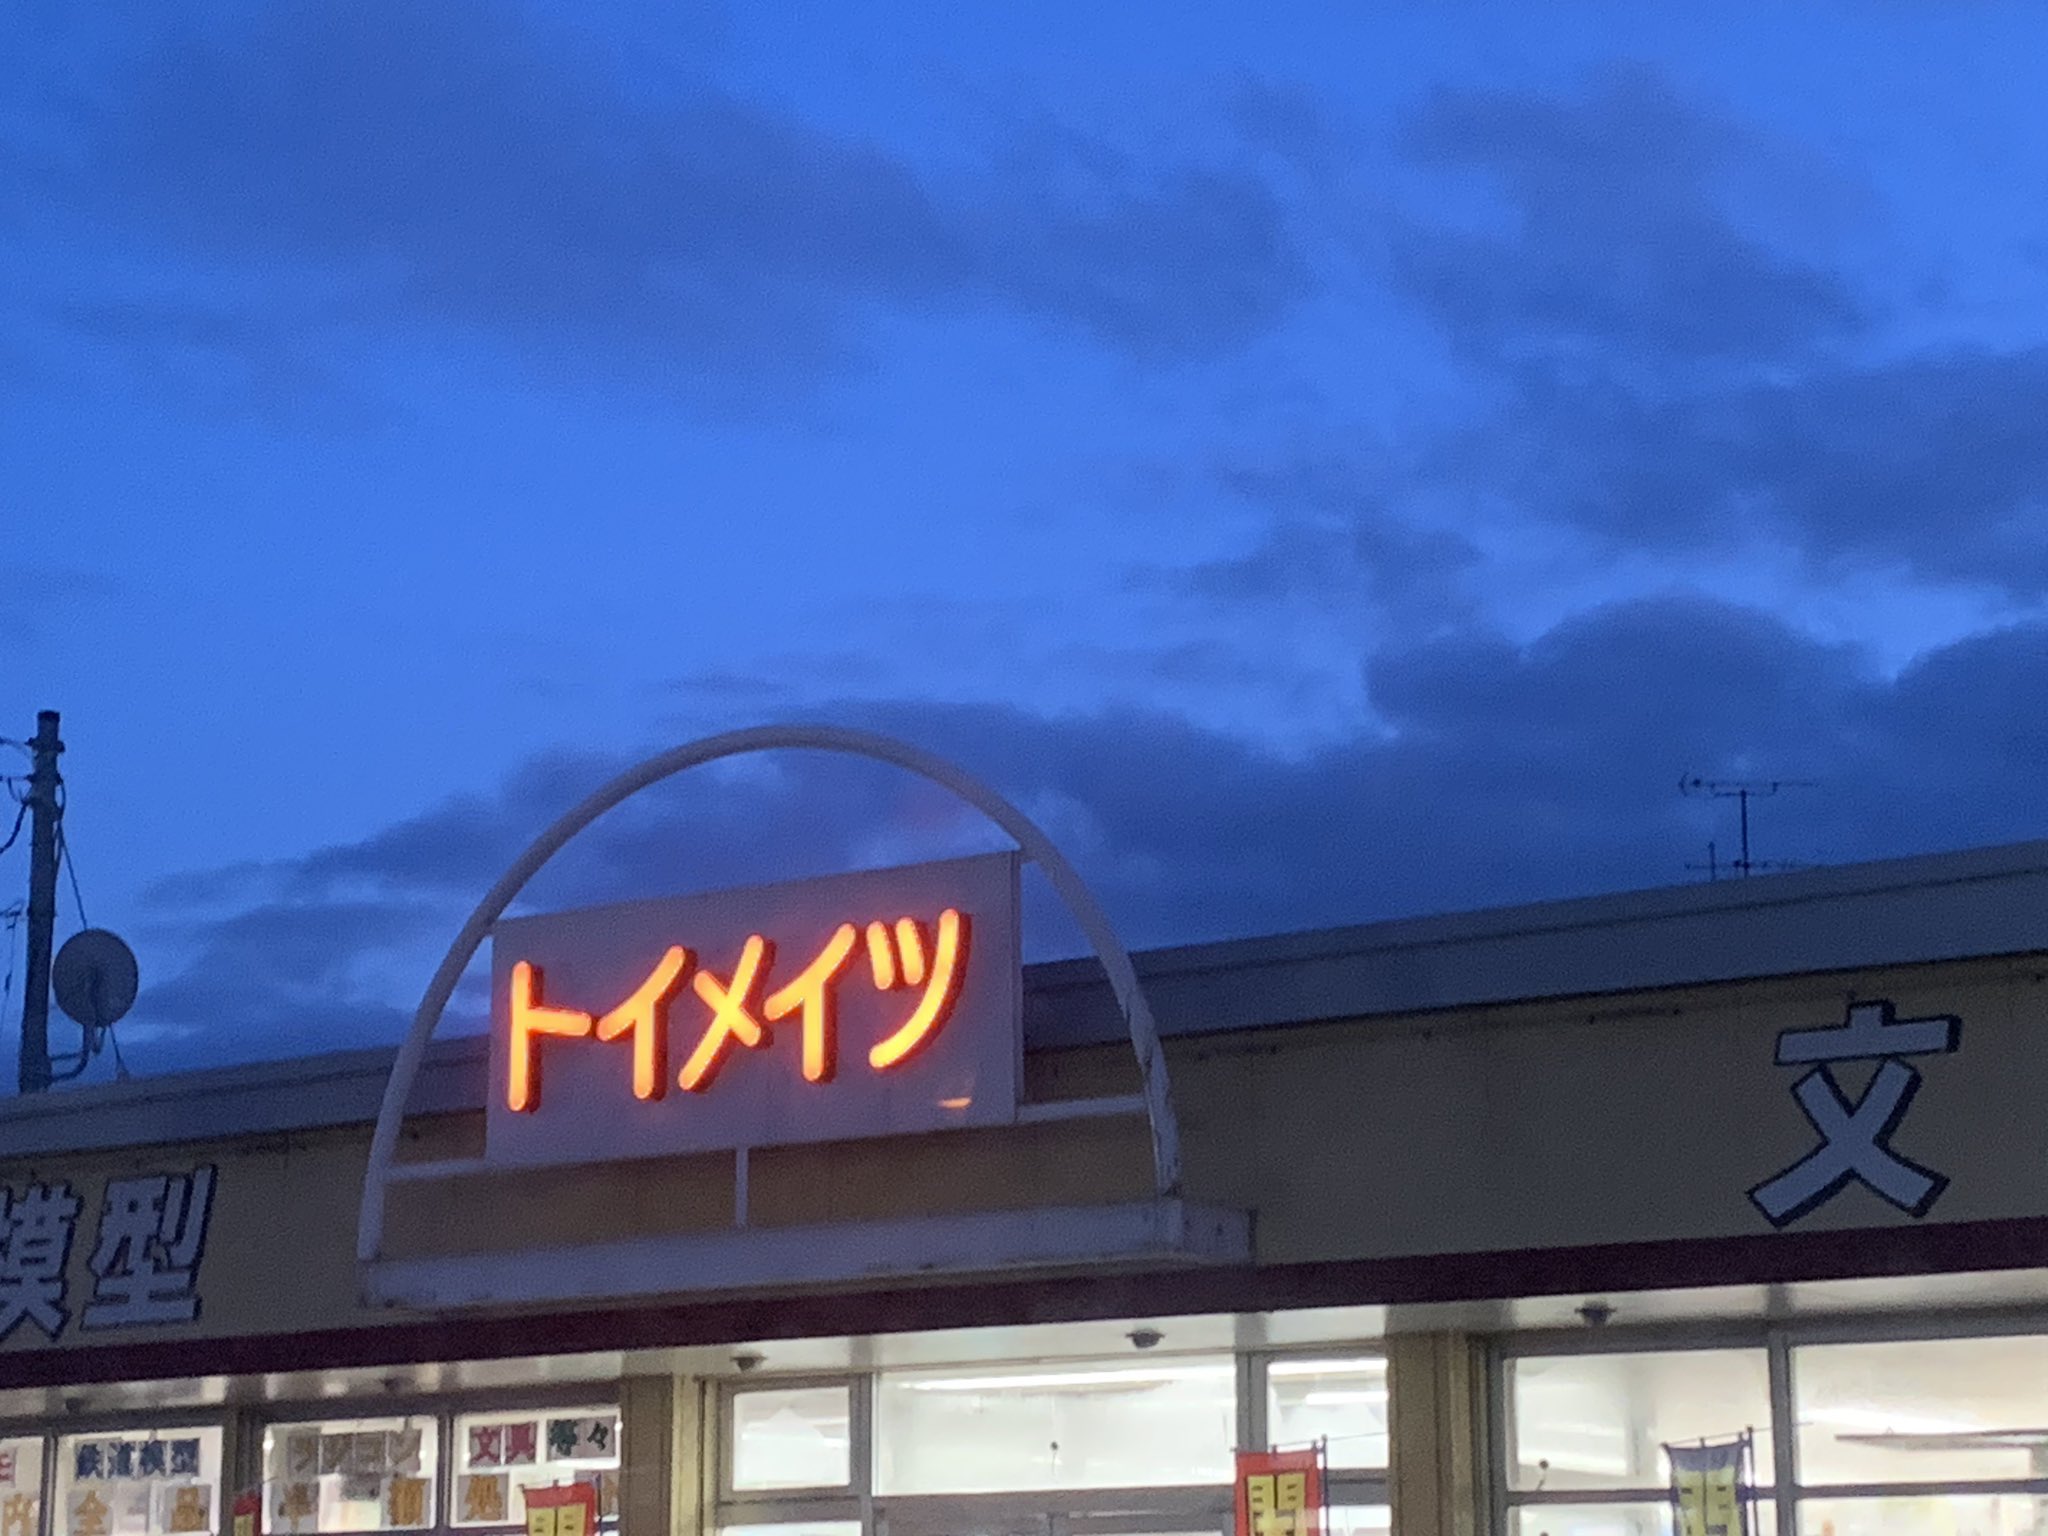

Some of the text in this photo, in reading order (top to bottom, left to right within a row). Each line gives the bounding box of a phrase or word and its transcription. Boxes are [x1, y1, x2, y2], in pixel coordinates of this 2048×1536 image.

[508, 908, 969, 1112] トイメイツ
[1747, 998, 1962, 1229] 文
